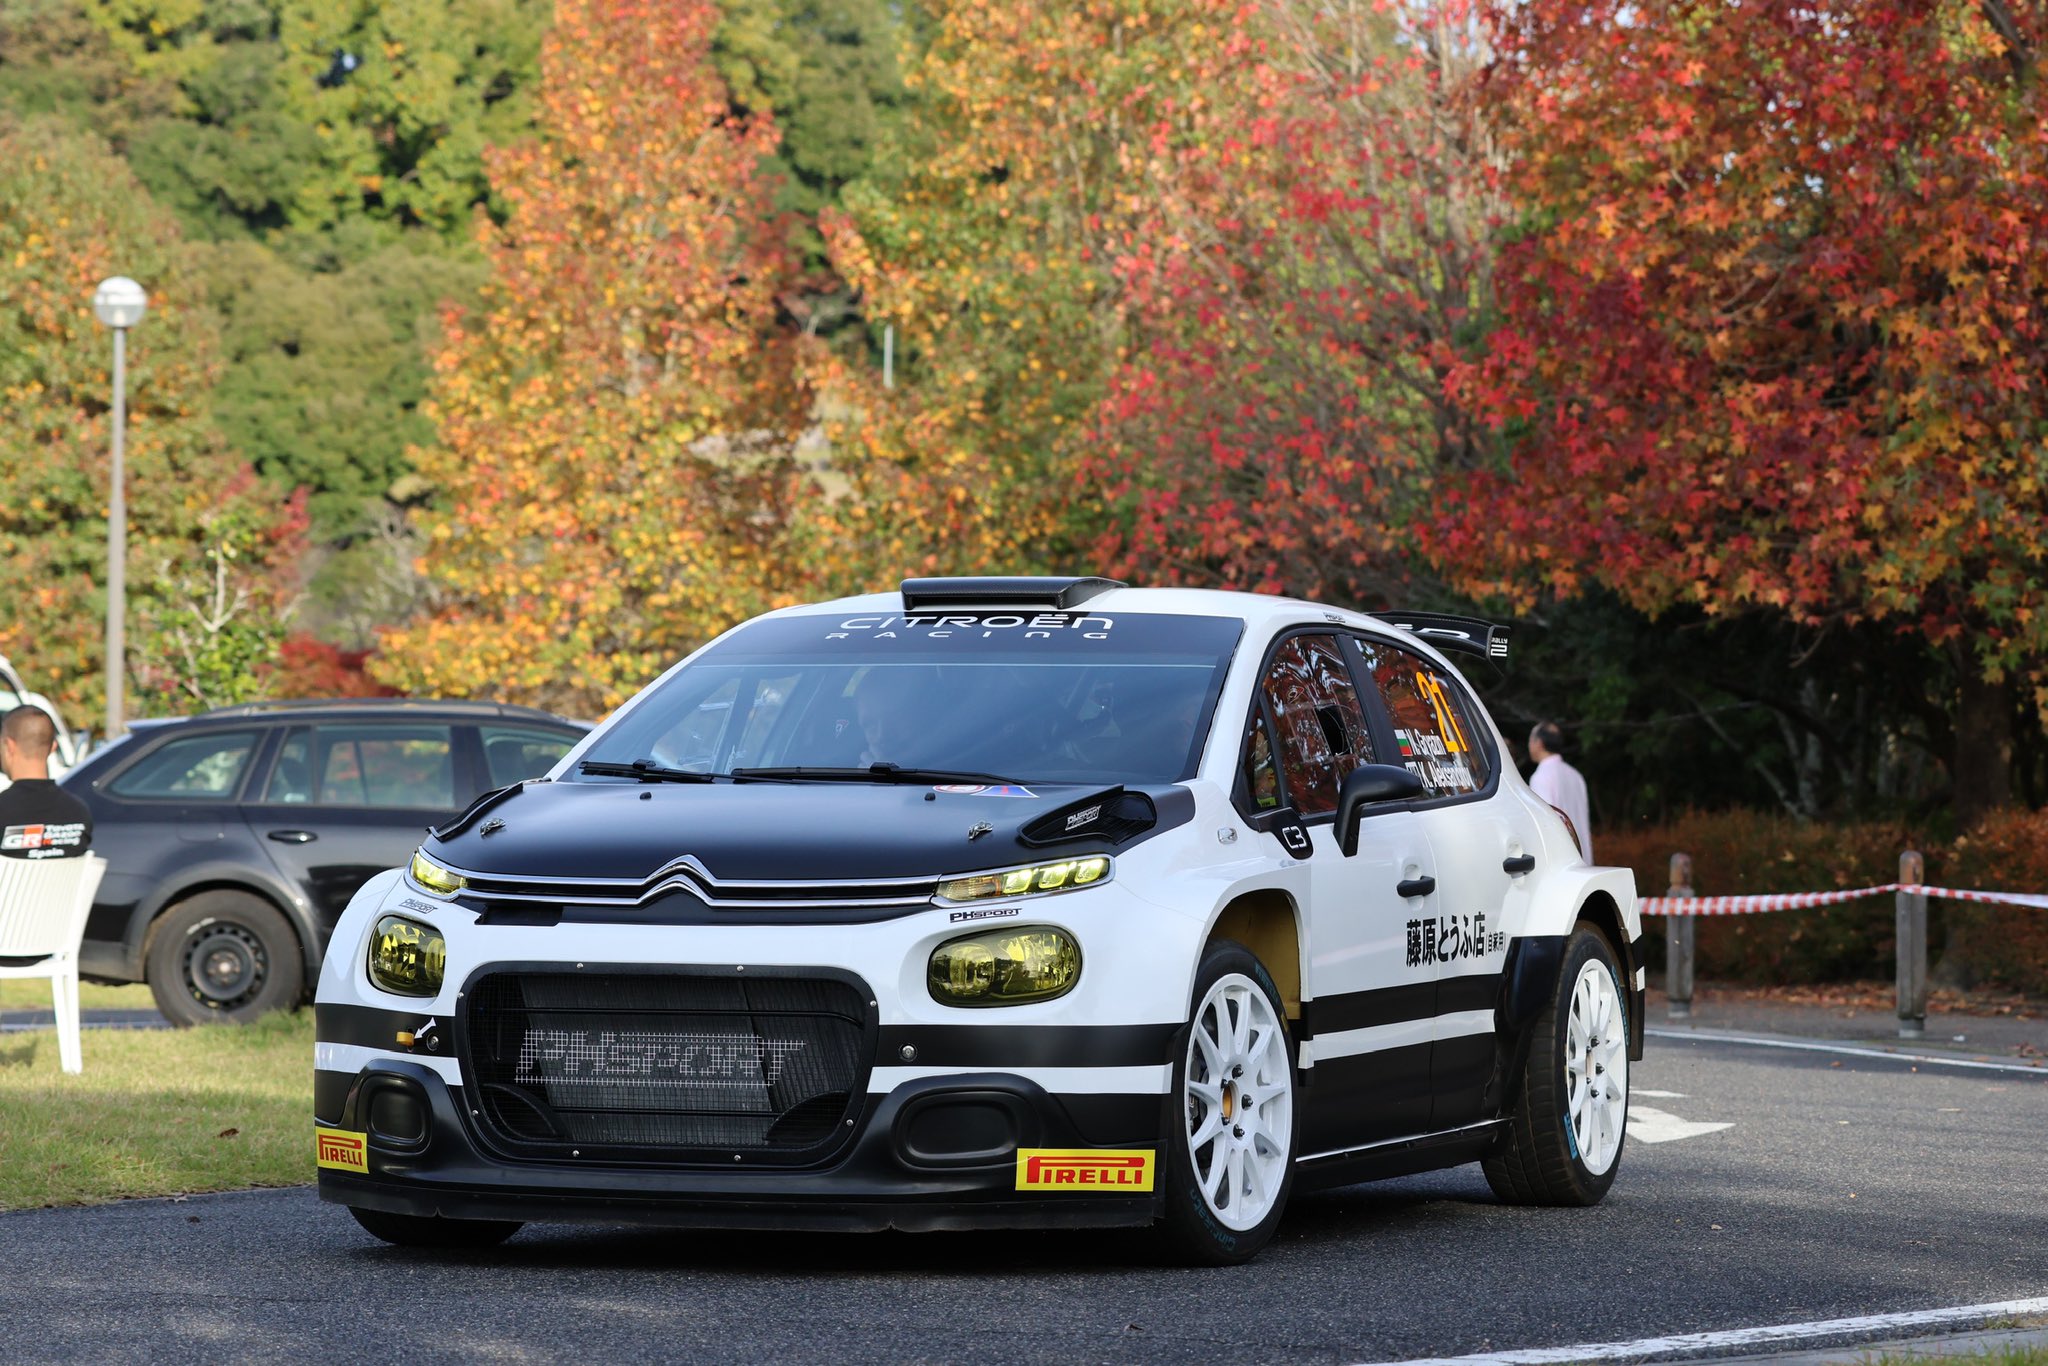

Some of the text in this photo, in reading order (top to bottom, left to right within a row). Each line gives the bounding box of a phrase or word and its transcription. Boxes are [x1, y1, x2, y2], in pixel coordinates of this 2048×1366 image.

[825, 631, 1108, 640] RACING
[1416, 671, 1469, 753] 21
[1282, 826, 1307, 849] C3
[28, 847, 65, 859] Spain
[319, 1134, 363, 1167] PIRELLI
[1027, 1156, 1145, 1184] PIRELLI
